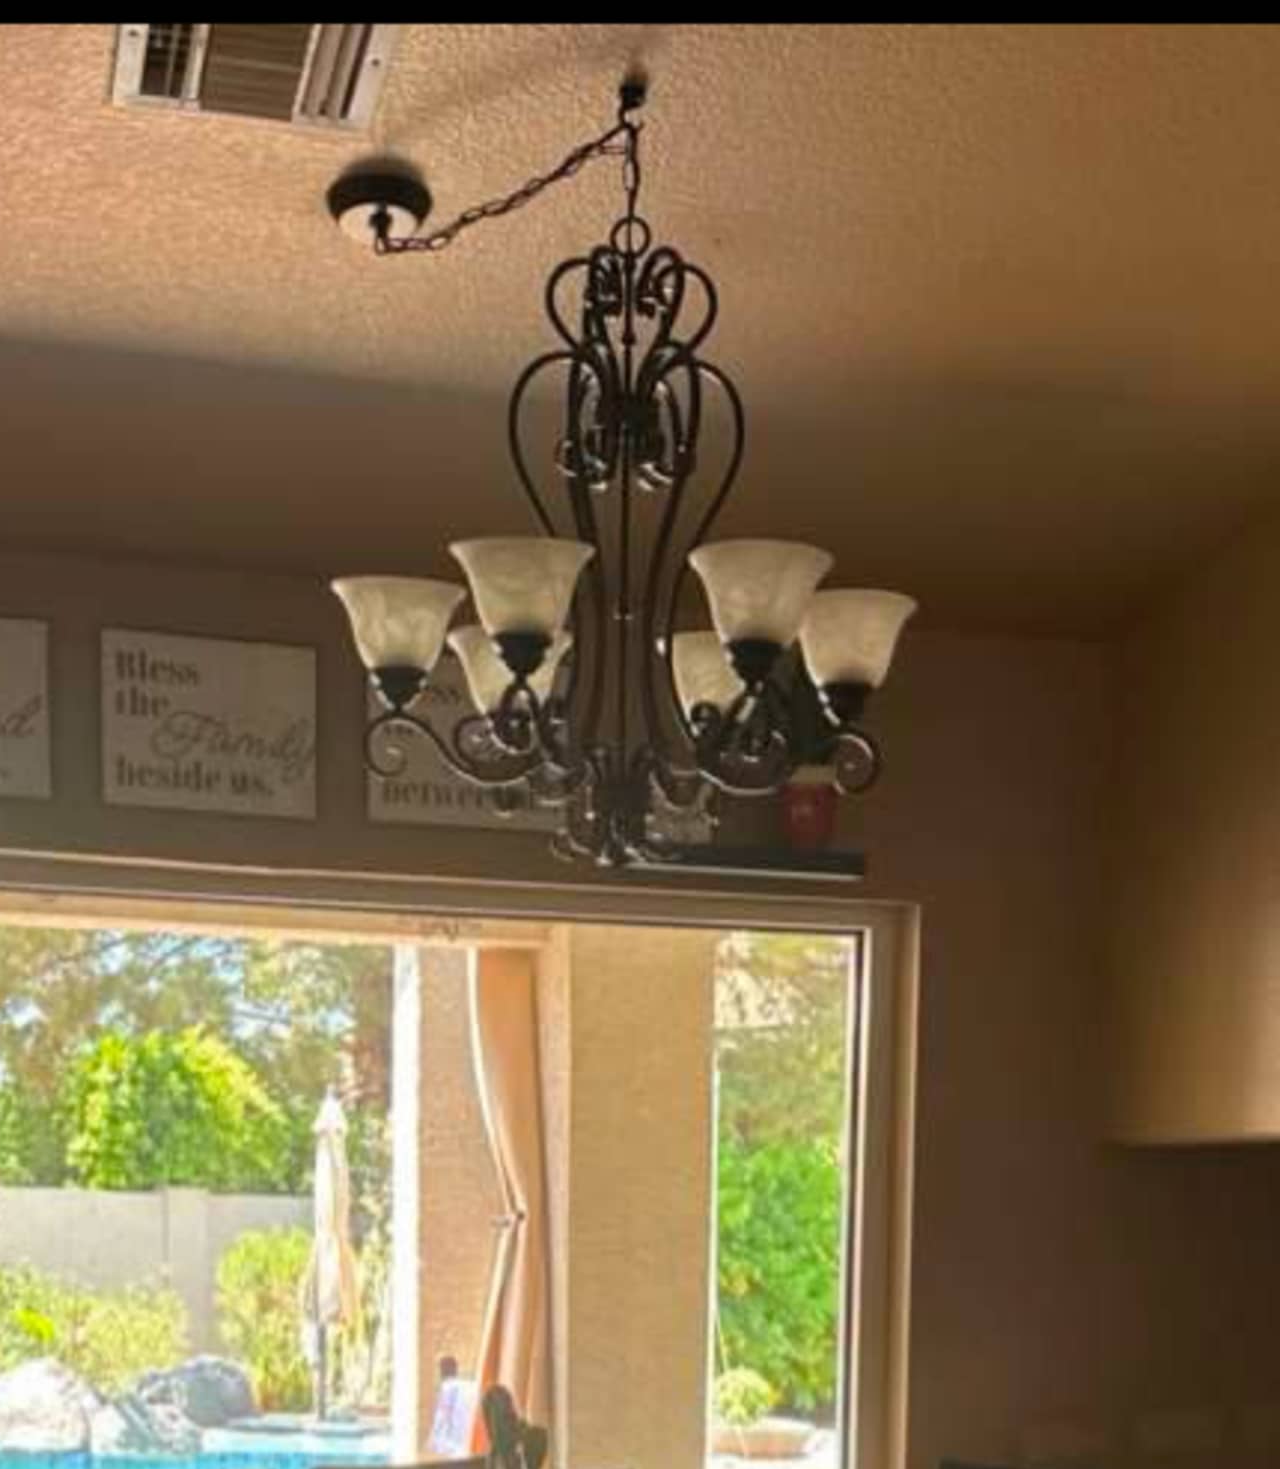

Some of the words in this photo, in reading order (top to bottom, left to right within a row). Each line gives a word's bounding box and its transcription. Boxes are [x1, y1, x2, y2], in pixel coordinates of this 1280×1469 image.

[114, 647, 203, 687] Bless
[114, 686, 171, 718] the
[116, 751, 222, 793] beside
[230, 769, 277, 798] us.
